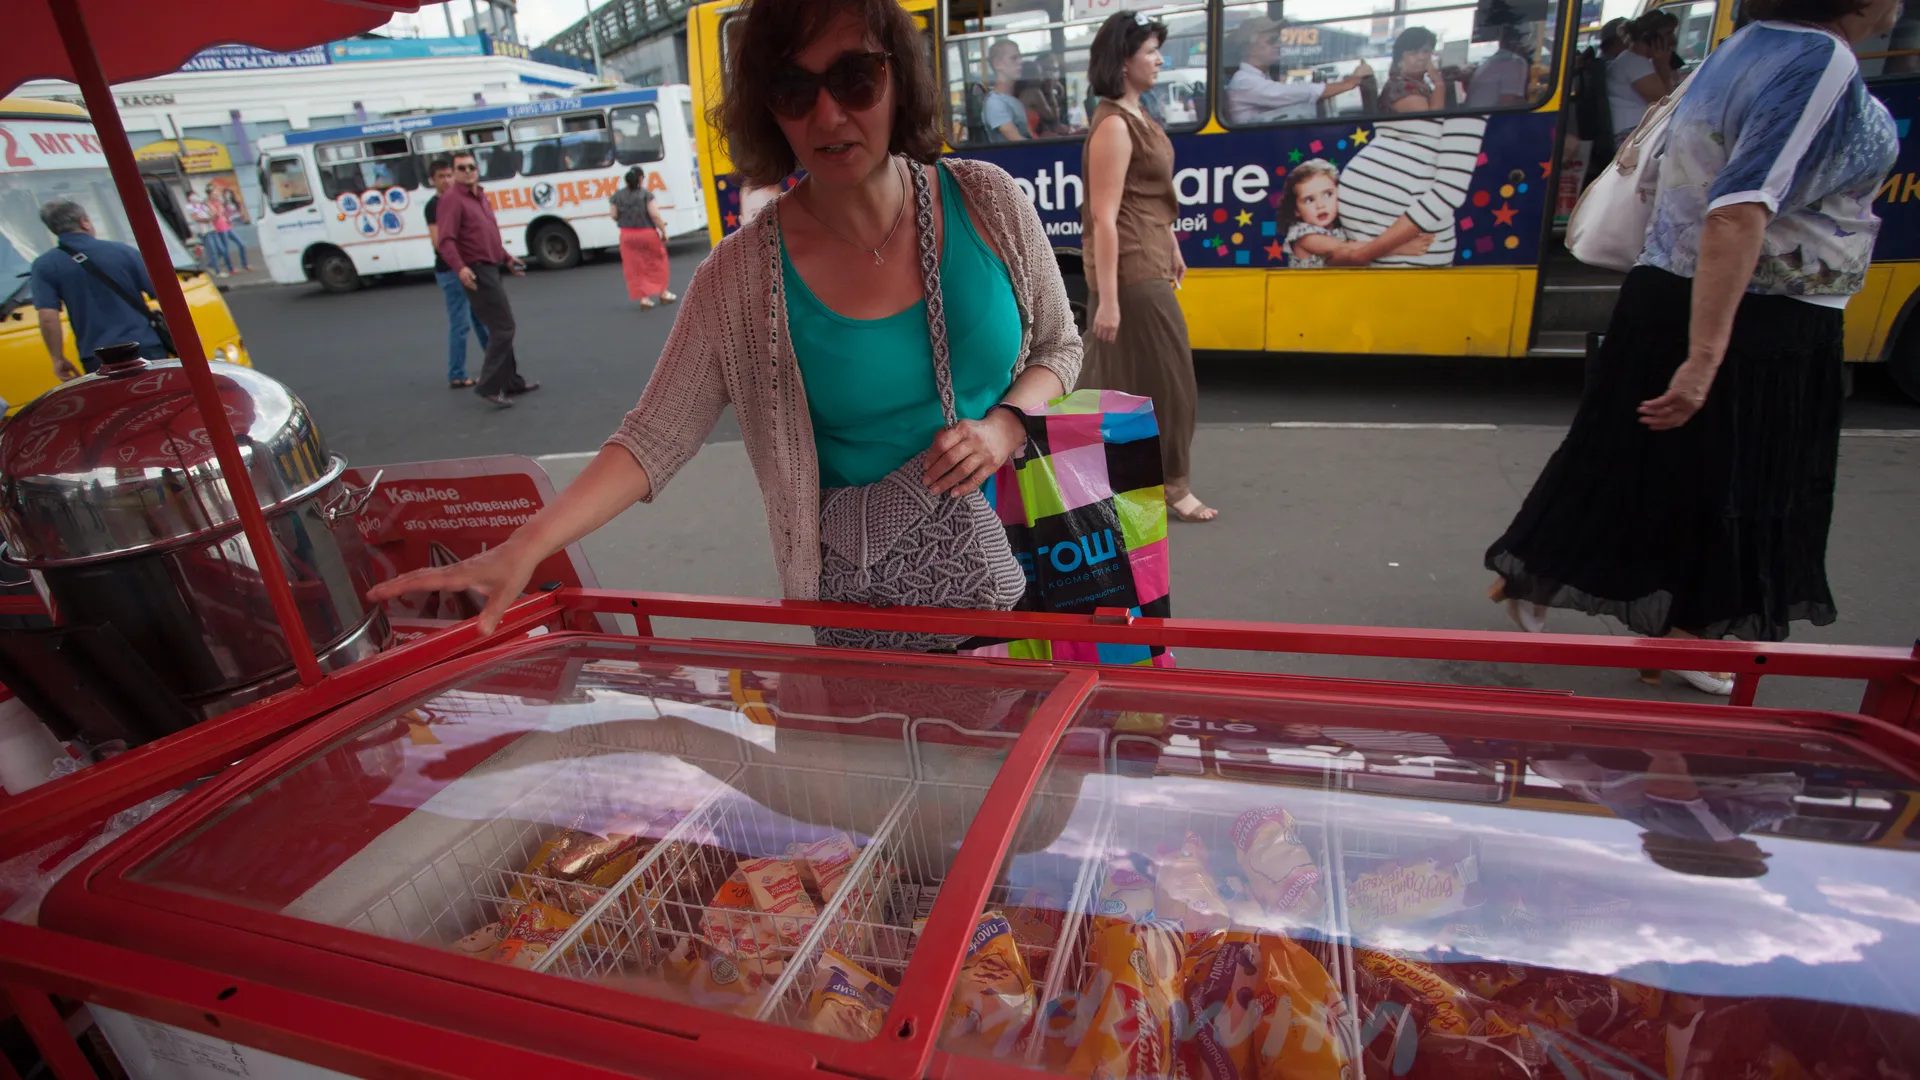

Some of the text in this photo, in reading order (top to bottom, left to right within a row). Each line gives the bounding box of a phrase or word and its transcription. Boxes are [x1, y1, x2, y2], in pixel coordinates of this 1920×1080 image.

[383, 486, 460, 505] Каждое
[403, 519, 427, 531] это
[1048, 562, 1120, 589] косметика
[1278, 872, 1318, 910] ПЛОМБИР
